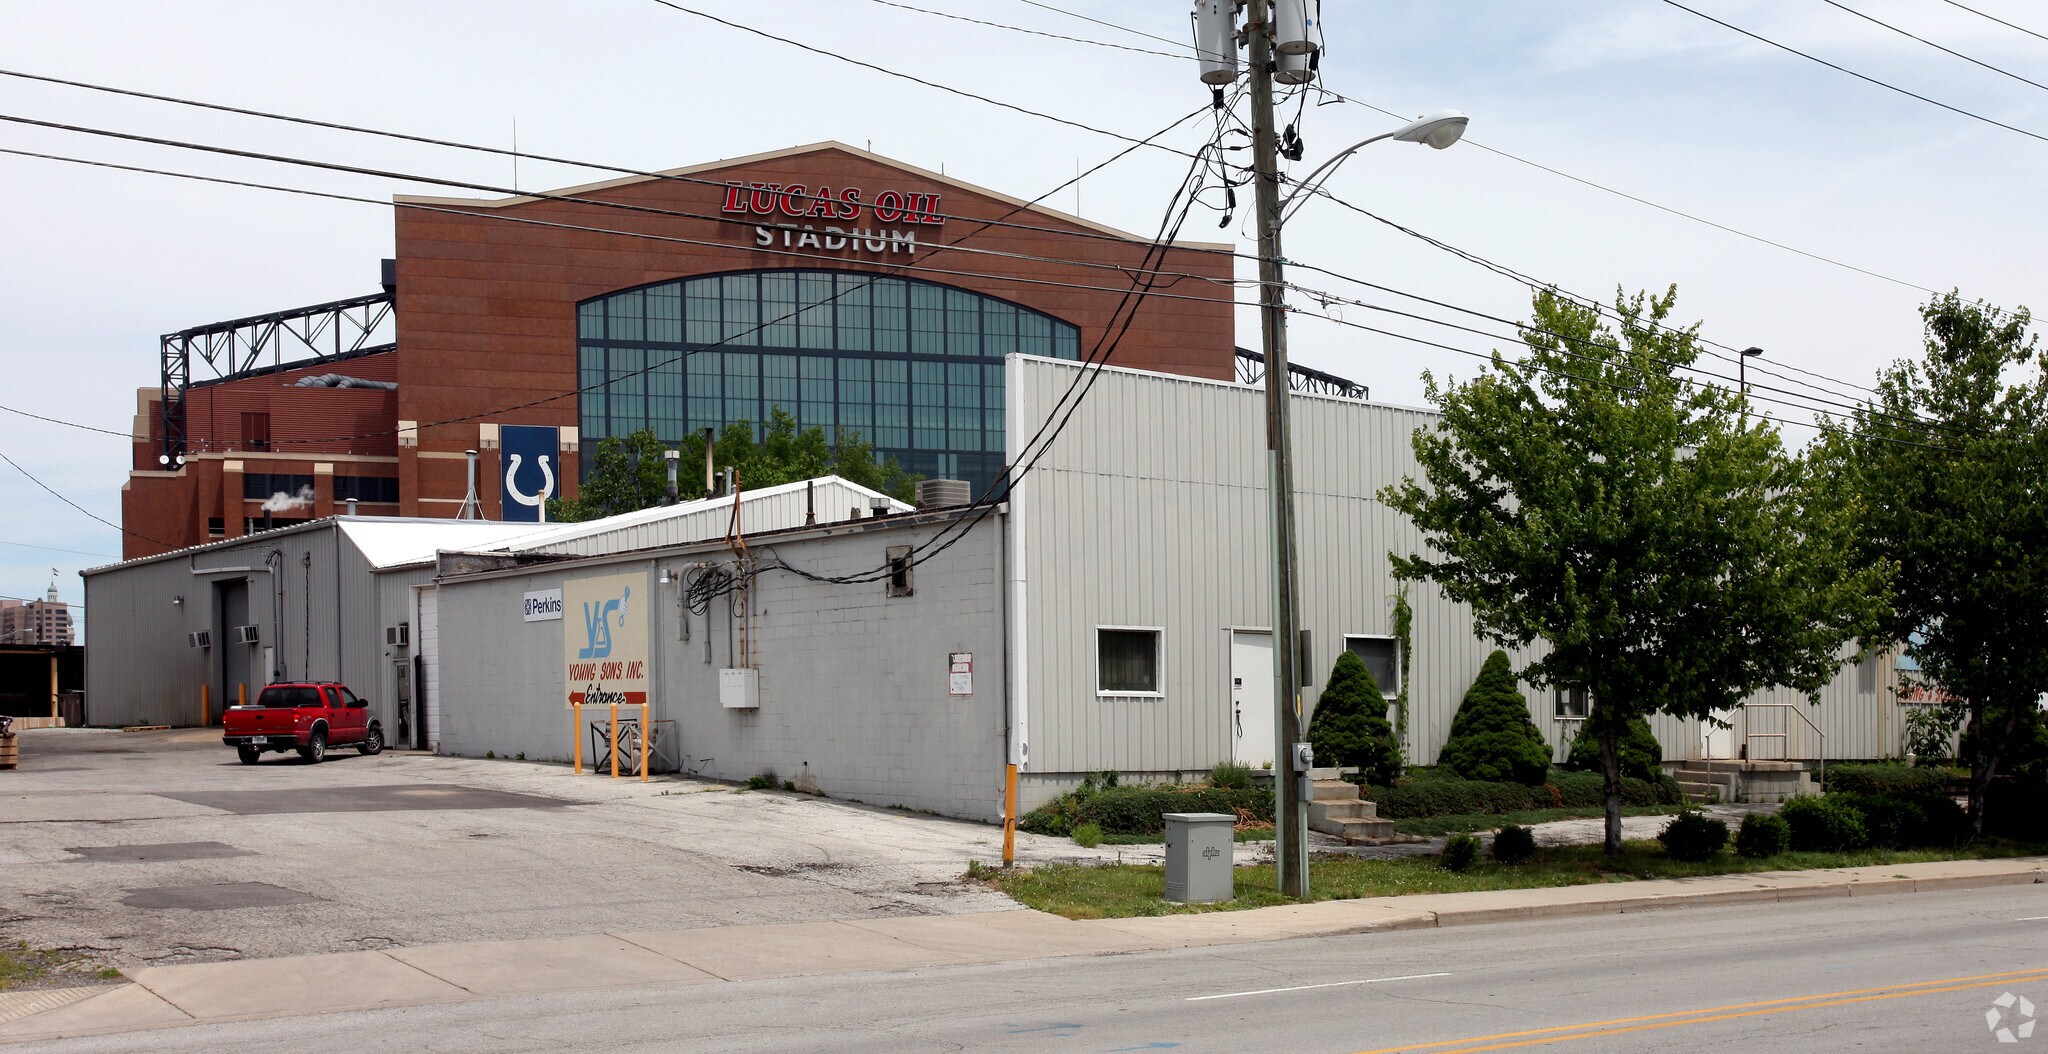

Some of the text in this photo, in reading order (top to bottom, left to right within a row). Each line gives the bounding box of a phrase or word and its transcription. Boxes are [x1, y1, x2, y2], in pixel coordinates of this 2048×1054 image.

[722, 181, 946, 224] LUCAS OIL
[756, 222, 916, 254] STADIUM
[532, 597, 561, 614] Perkins
[569, 663, 596, 681] YOUNG
[585, 683, 625, 704] Entrance
